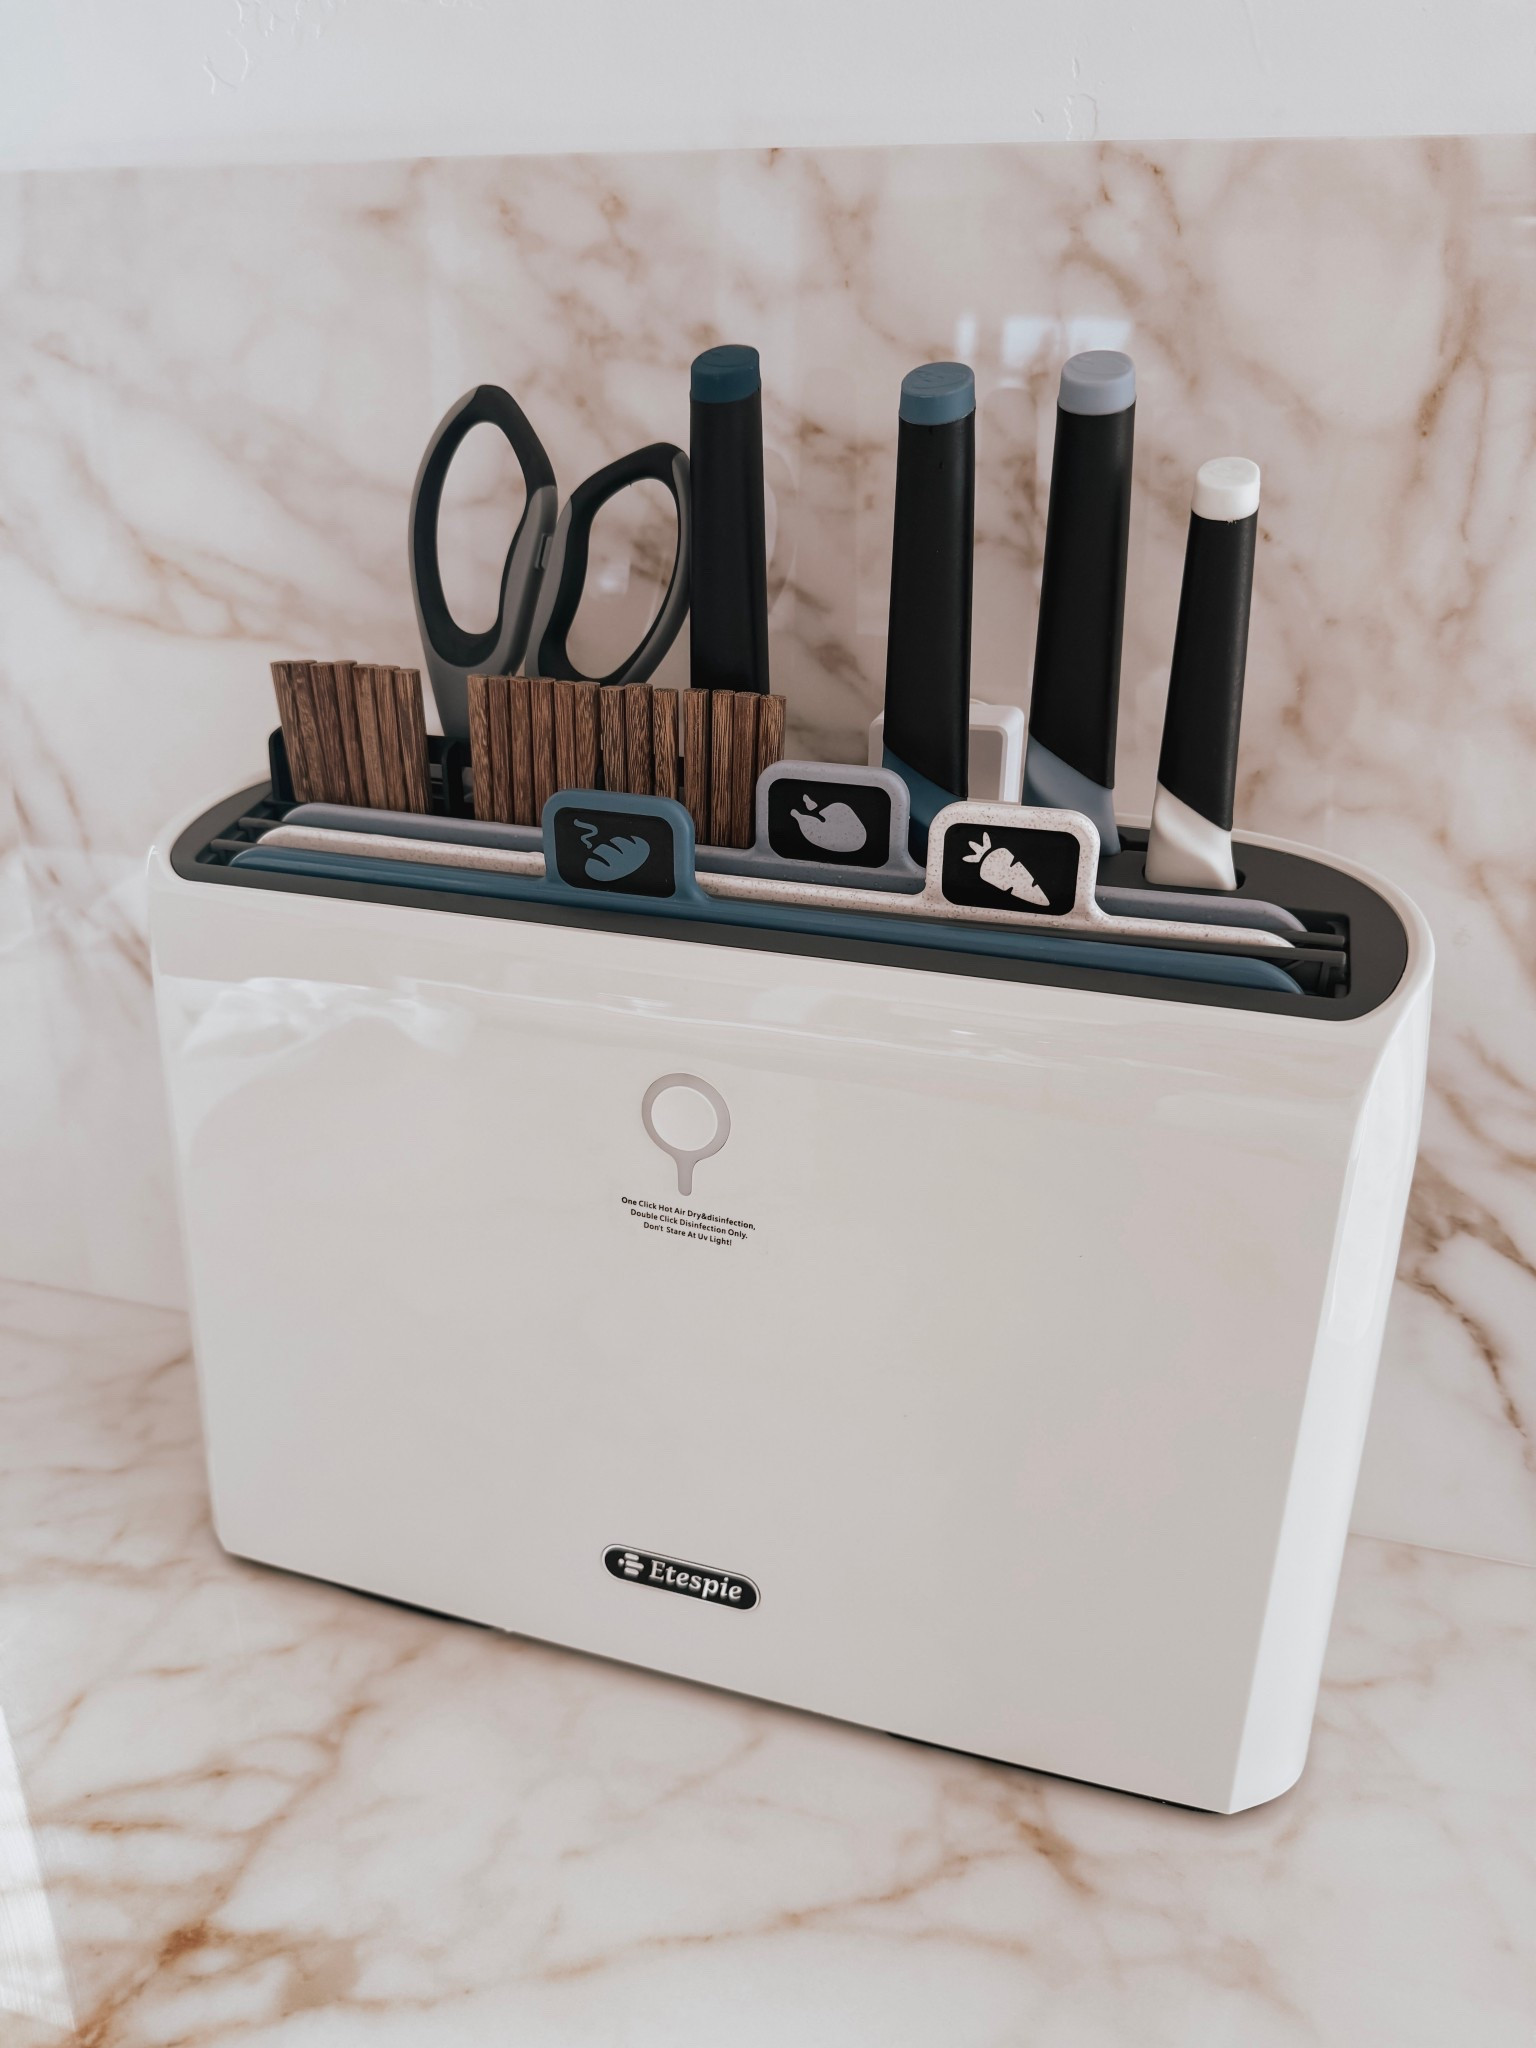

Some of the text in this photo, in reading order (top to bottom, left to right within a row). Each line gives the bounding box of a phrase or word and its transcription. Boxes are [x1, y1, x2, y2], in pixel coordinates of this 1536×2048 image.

[621, 1196, 756, 1231] One Click Hot Air Dry&disinfection,
[630, 1209, 748, 1239] Double Click Disinfection Only.
[643, 1222, 732, 1246] Don't Stare At Uv Light!
[649, 1559, 743, 1601] Etespie
